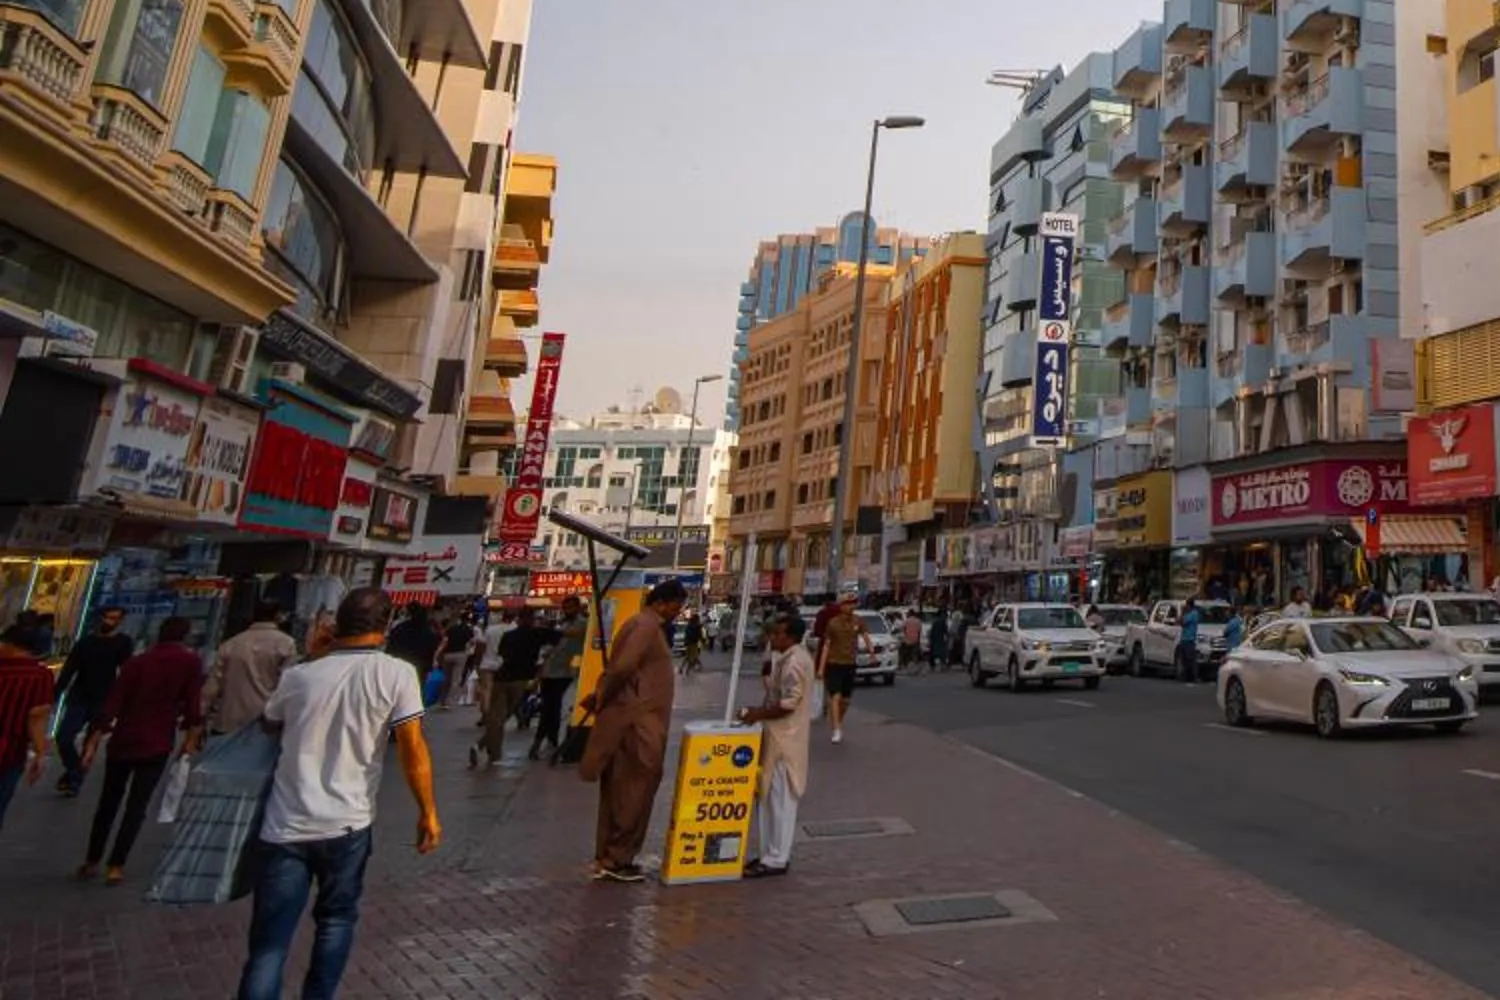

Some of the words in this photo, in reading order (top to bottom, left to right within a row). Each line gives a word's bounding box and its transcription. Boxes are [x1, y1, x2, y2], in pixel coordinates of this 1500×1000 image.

[1045, 217, 1075, 233] HOTEL
[1240, 481, 1310, 511] METRO
[384, 565, 454, 584] TEX
[695, 802, 748, 822] 5000
